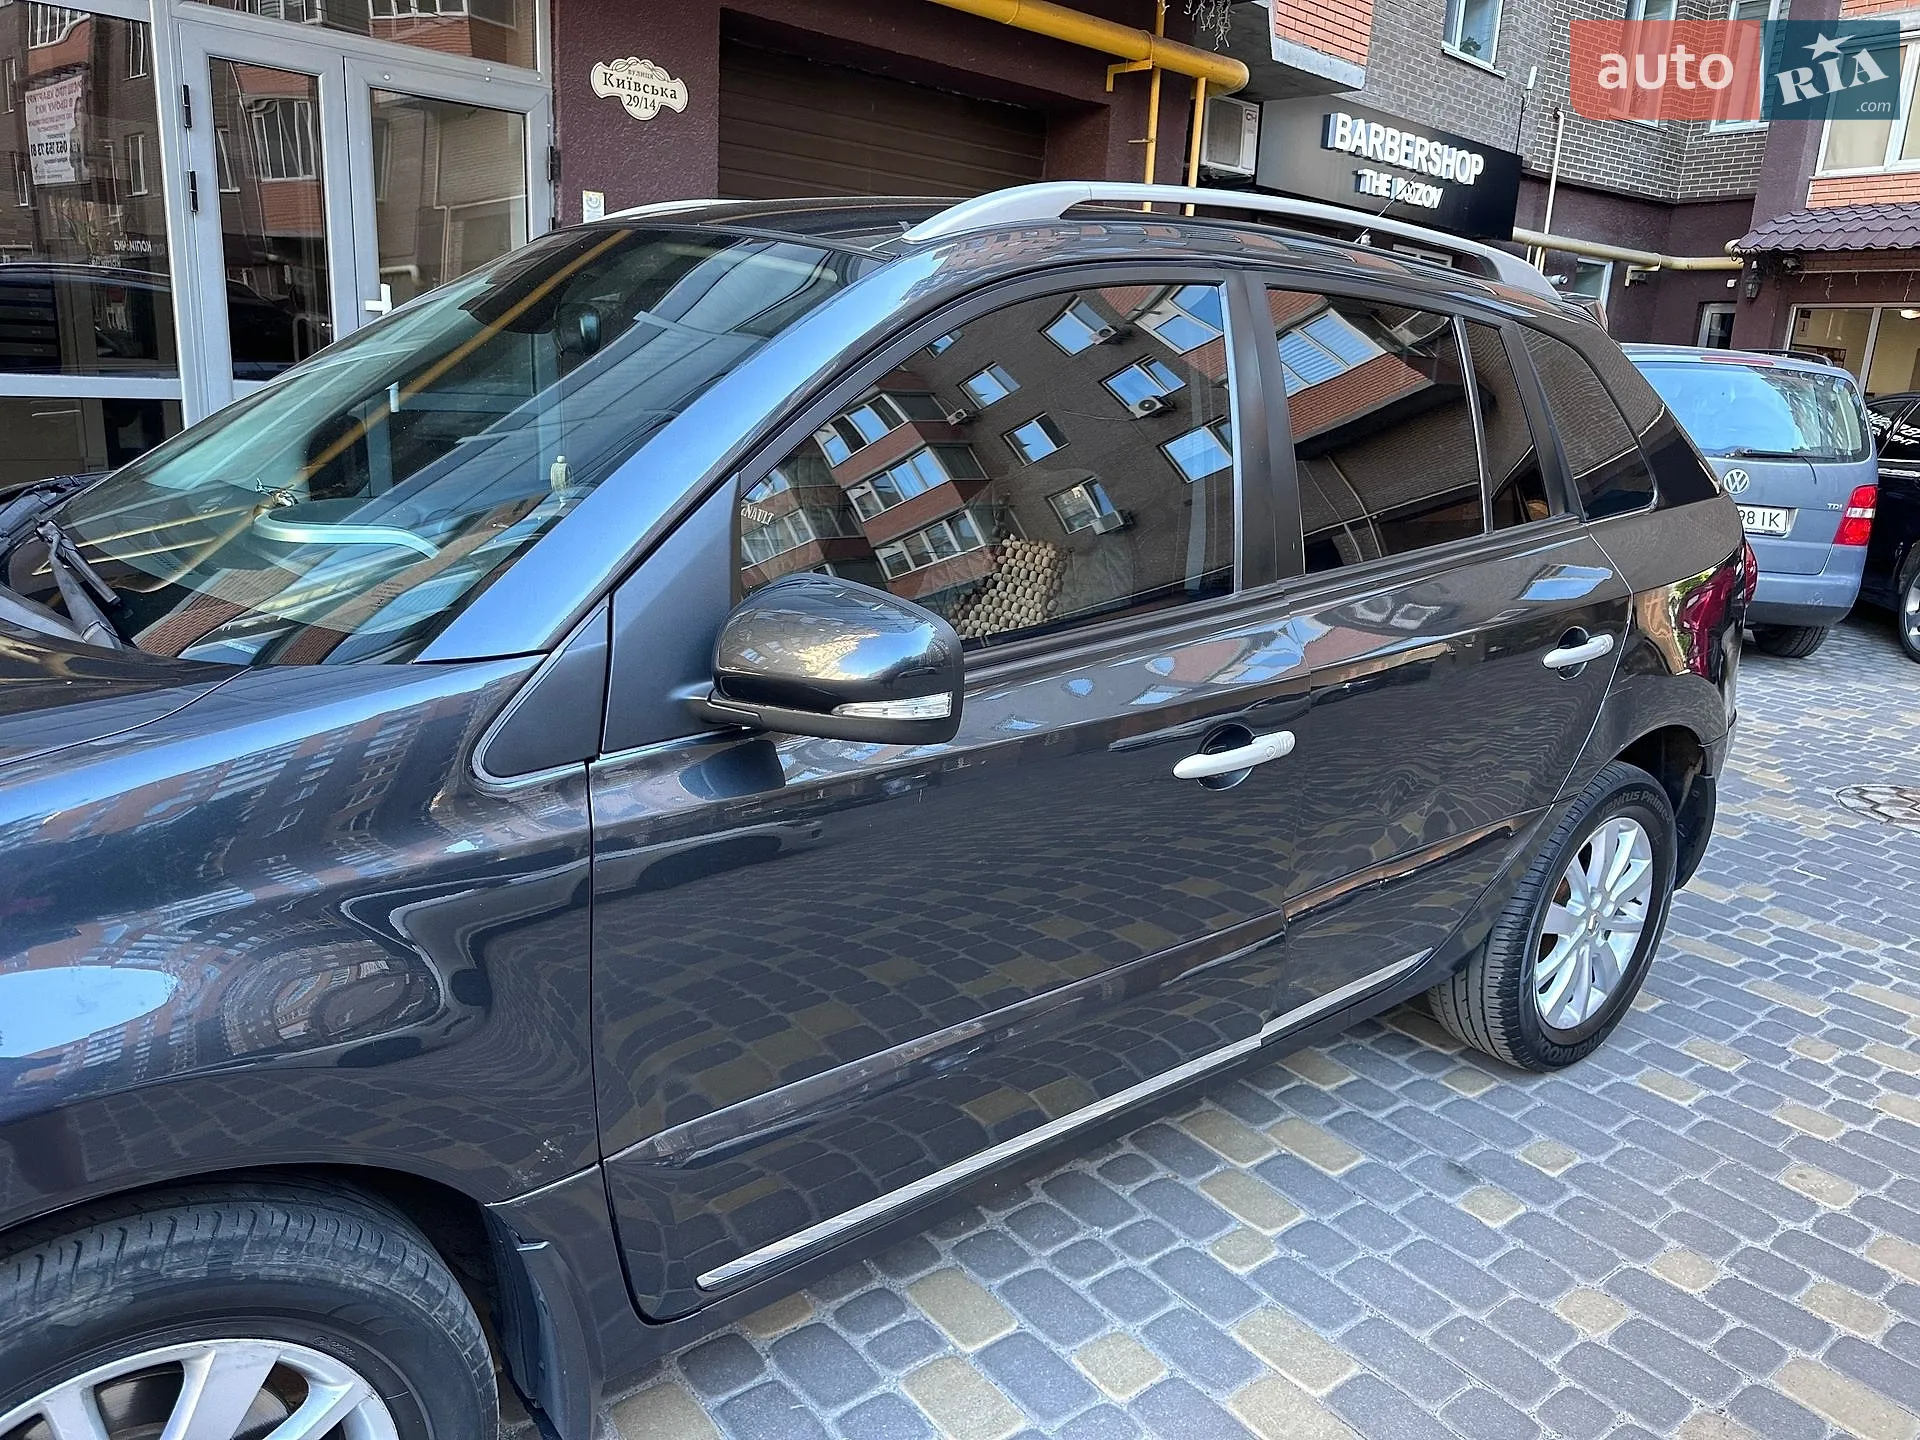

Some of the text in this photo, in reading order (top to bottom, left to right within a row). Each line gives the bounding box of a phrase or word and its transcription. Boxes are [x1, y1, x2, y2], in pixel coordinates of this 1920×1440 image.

[603, 72, 678, 100] Київська
[626, 94, 656, 111] 29/14
[1328, 112, 1485, 186] BARBERSHOP
[1356, 168, 1393, 198] THE
